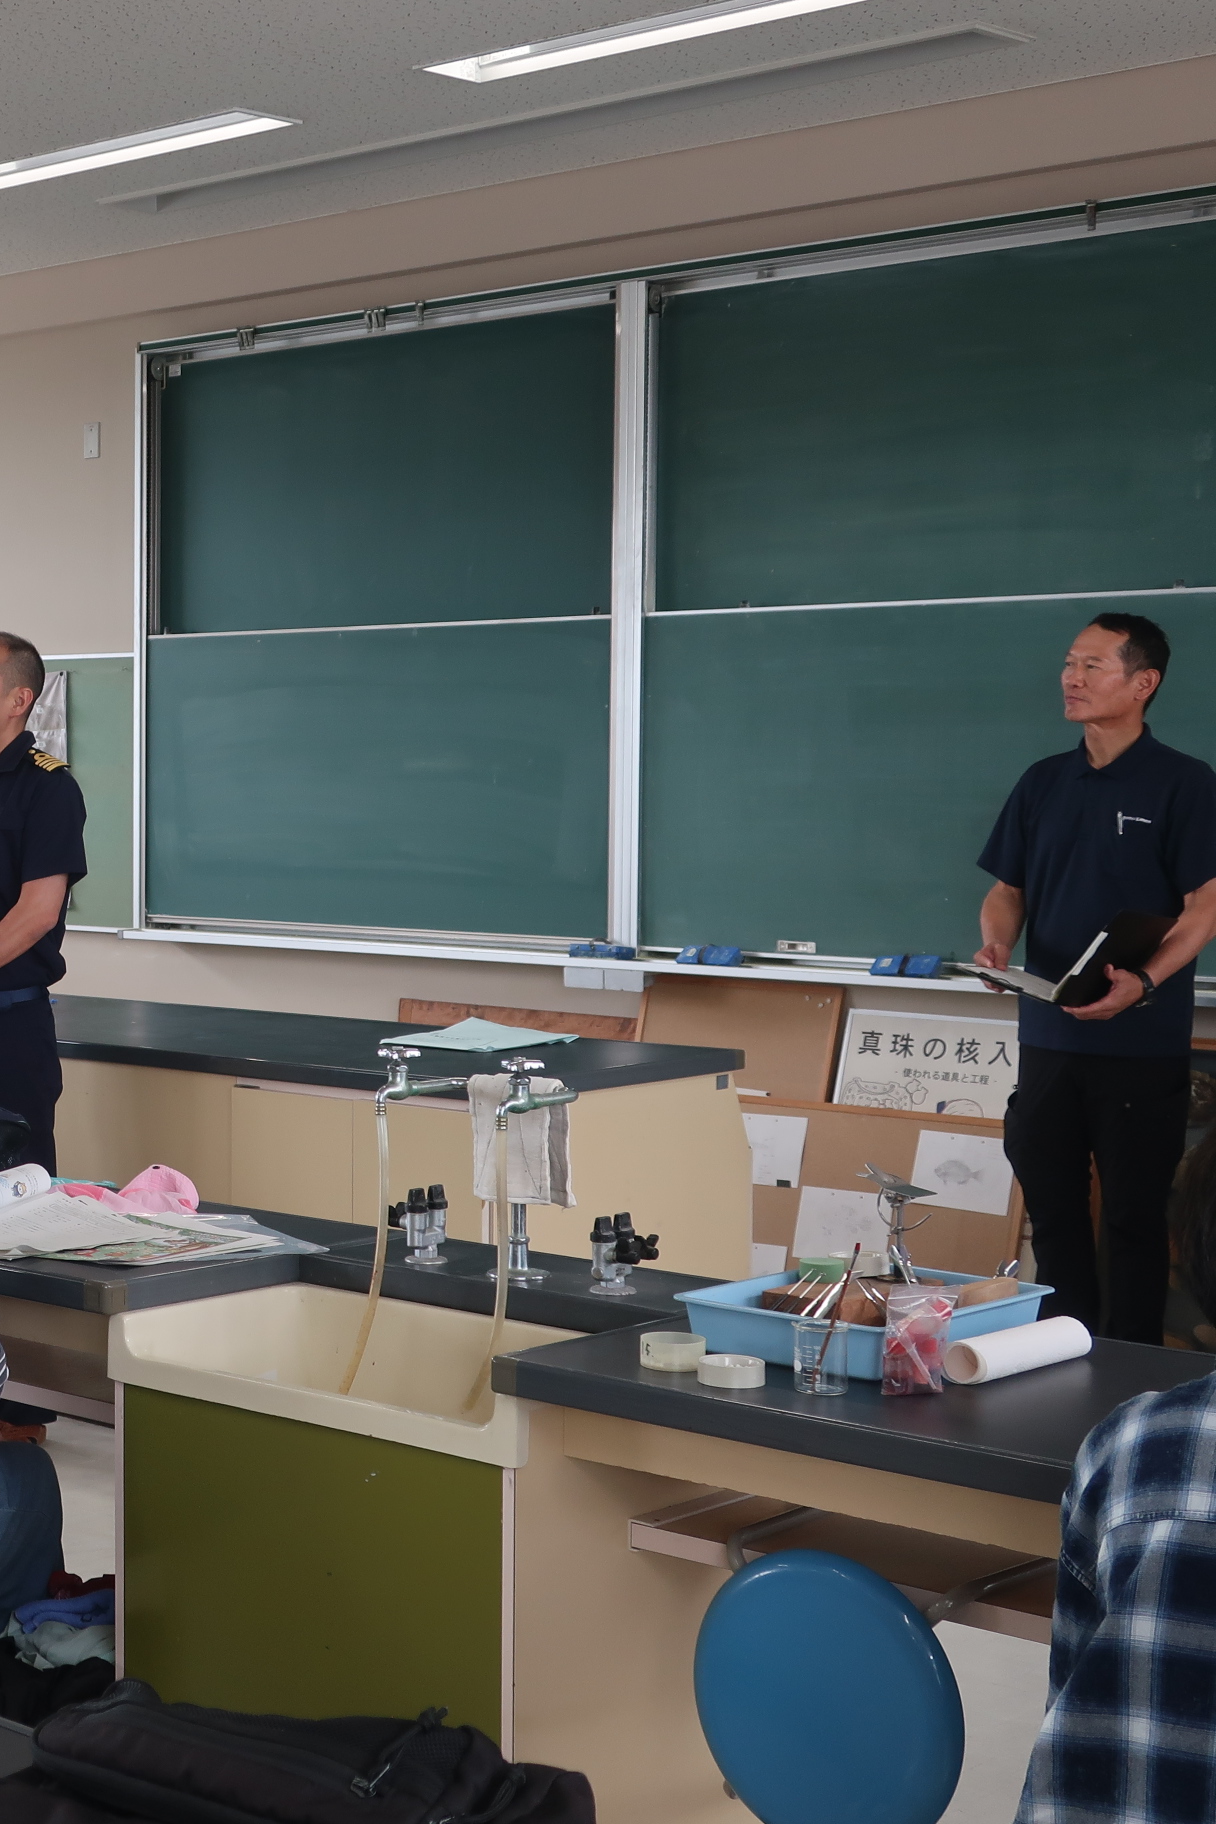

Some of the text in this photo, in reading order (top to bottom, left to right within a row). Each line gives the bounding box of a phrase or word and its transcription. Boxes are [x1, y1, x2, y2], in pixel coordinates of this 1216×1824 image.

[858, 1030, 1012, 1067] 真珠の核入
